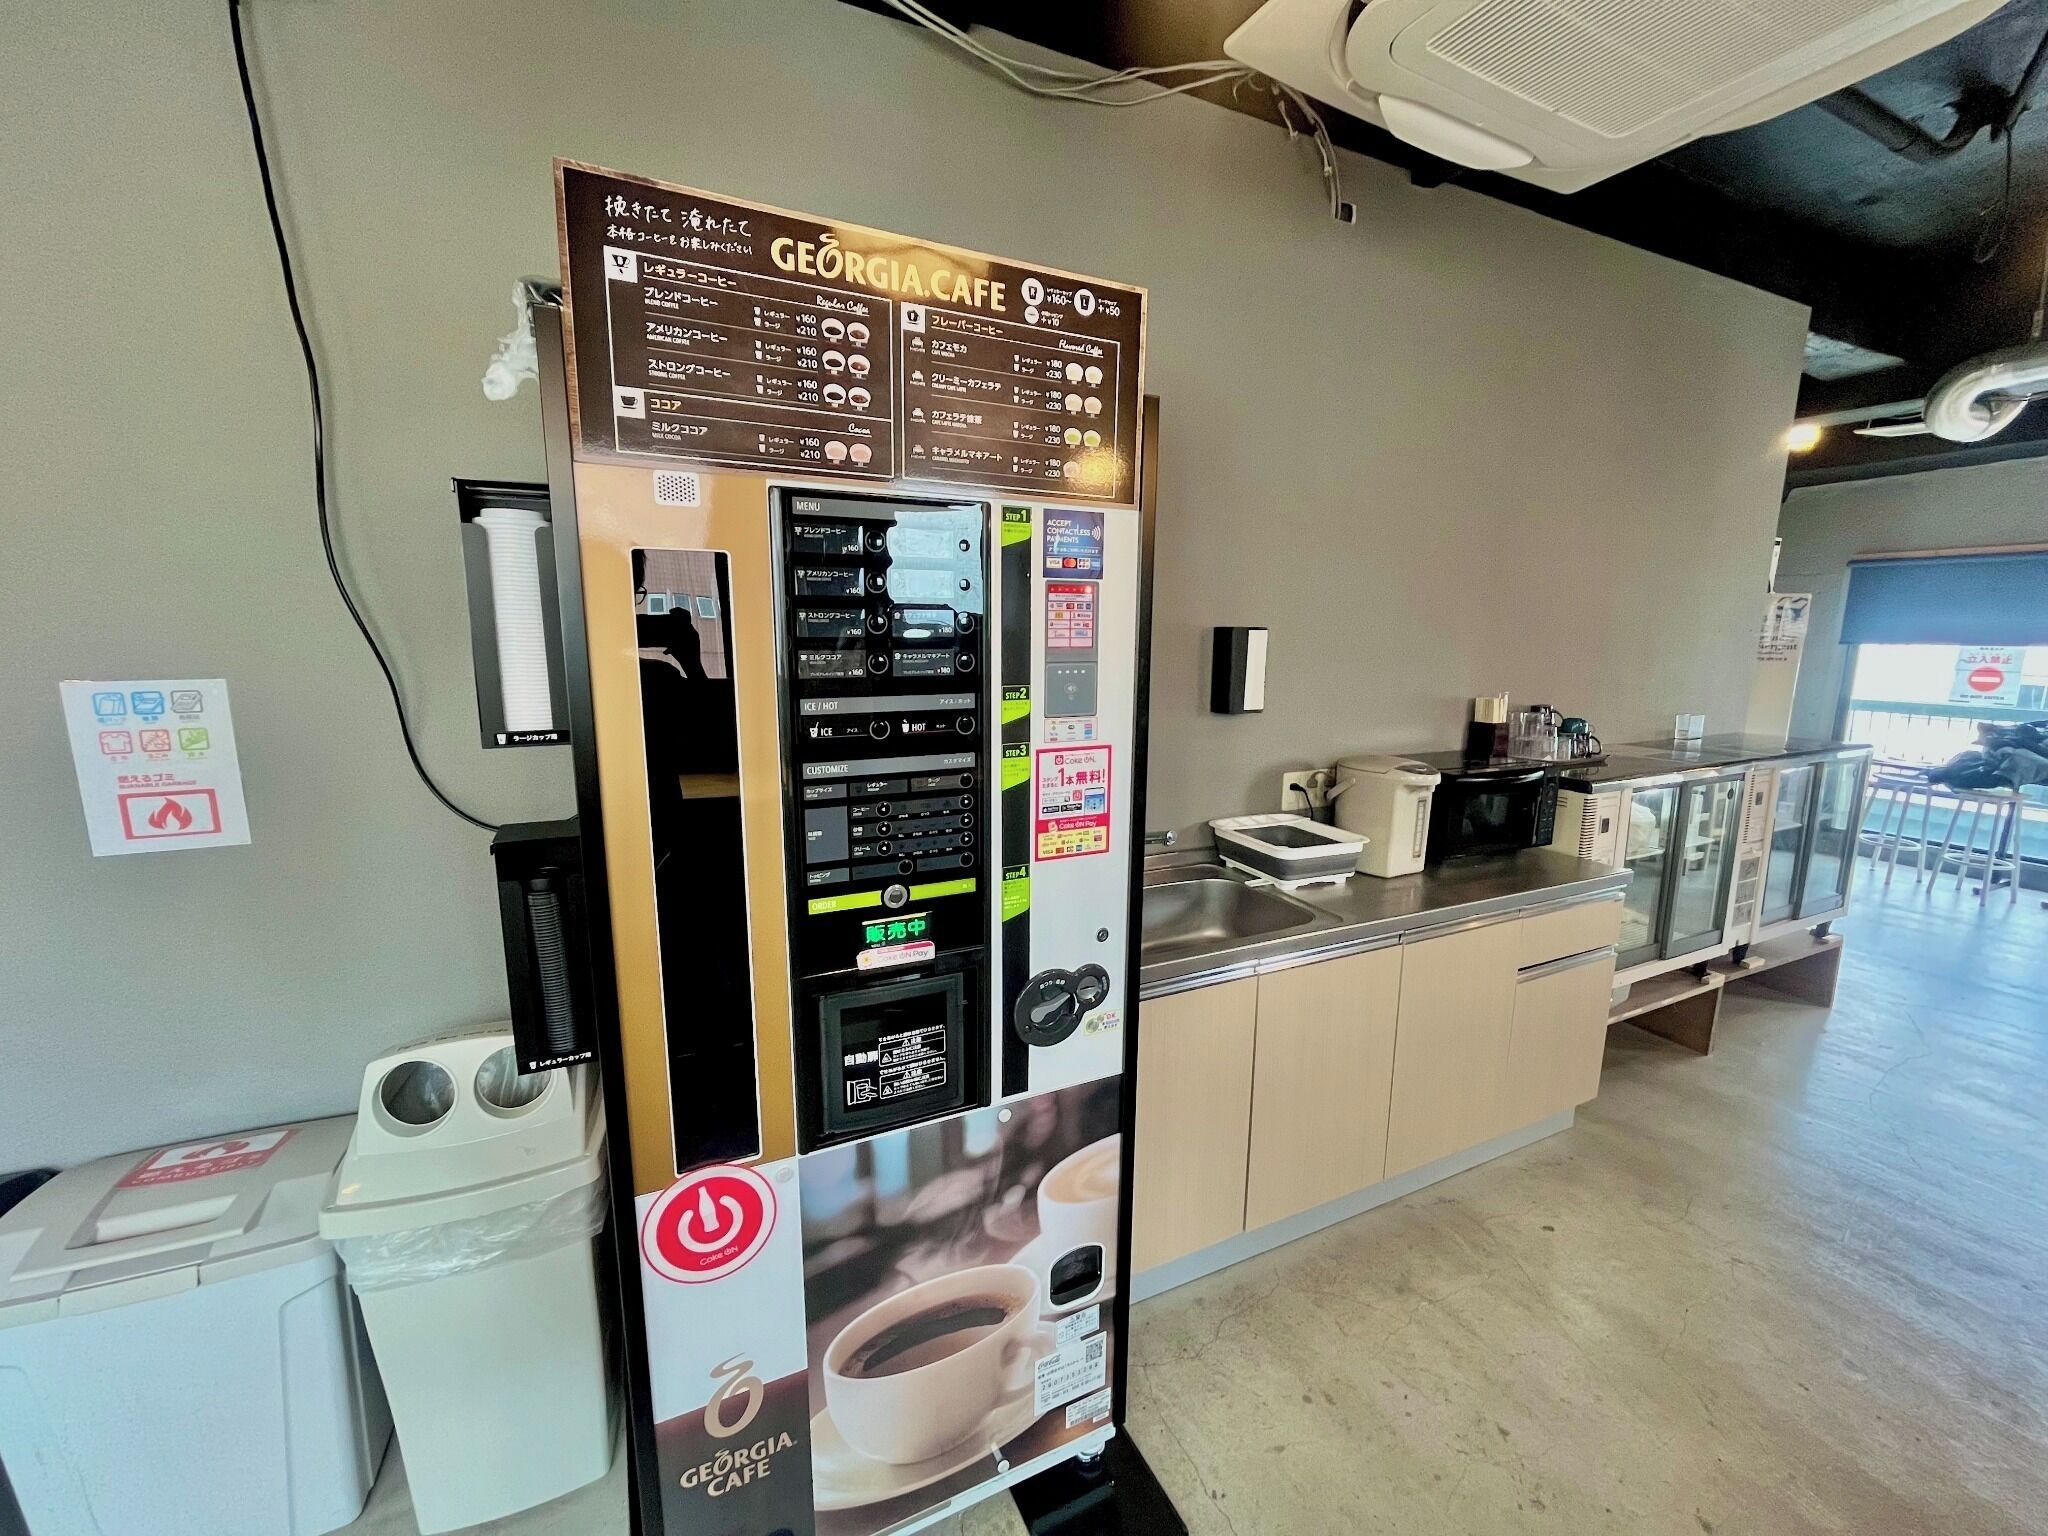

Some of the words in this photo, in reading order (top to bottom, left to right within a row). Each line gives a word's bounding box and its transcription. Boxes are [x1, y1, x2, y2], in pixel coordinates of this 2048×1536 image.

[604, 195, 672, 223] 挽きたて
[680, 208, 752, 237] 淹れたて
[607, 224, 753, 255] 本格コーヒーをお楽しみください
[644, 262, 737, 287] レギュラーコーヒー
[644, 287, 718, 307] ブレンドコーヒー
[816, 295, 846, 309] Regular
[846, 300, 870, 316] Coffee
[932, 315, 1004, 335] フレーバーコーヒー
[646, 322, 728, 342] アメリカンコーヒー
[797, 326, 817, 336] ¥210
[932, 340, 967, 353] カフェモカ
[1059, 339, 1085, 353] Flavored
[1085, 344, 1103, 358] Coffee
[648, 359, 731, 378] ストロングコーヒー
[797, 359, 818, 369] ¥210
[1046, 370, 1062, 379] ¥230
[798, 392, 818, 402] ¥210
[650, 399, 681, 410] ココア
[1046, 402, 1062, 410] ¥230
[652, 421, 708, 435] ミルクココア
[848, 423, 871, 434] Cocoa
[1045, 436, 1060, 444] ¥230
[800, 450, 820, 459] ¥210
[932, 446, 1002, 461] キャラメルマキアート
[1045, 470, 1060, 478] ¥230
[797, 501, 820, 511] MENU
[1047, 527, 1091, 536] CONTACTLESS
[804, 702, 816, 711] ICE
[822, 701, 838, 710] HOT
[820, 728, 832, 736] ICE
[912, 723, 926, 732] HOT
[806, 764, 848, 775] CUSTOMIZE
[812, 900, 837, 910] ORDER
[866, 919, 926, 943] 販売中
[913, 949, 928, 958] Pay
[700, 1253, 723, 1266] Coke
[680, 1432, 793, 1488] GEORGIA
[708, 1459, 771, 1496] CAFE
